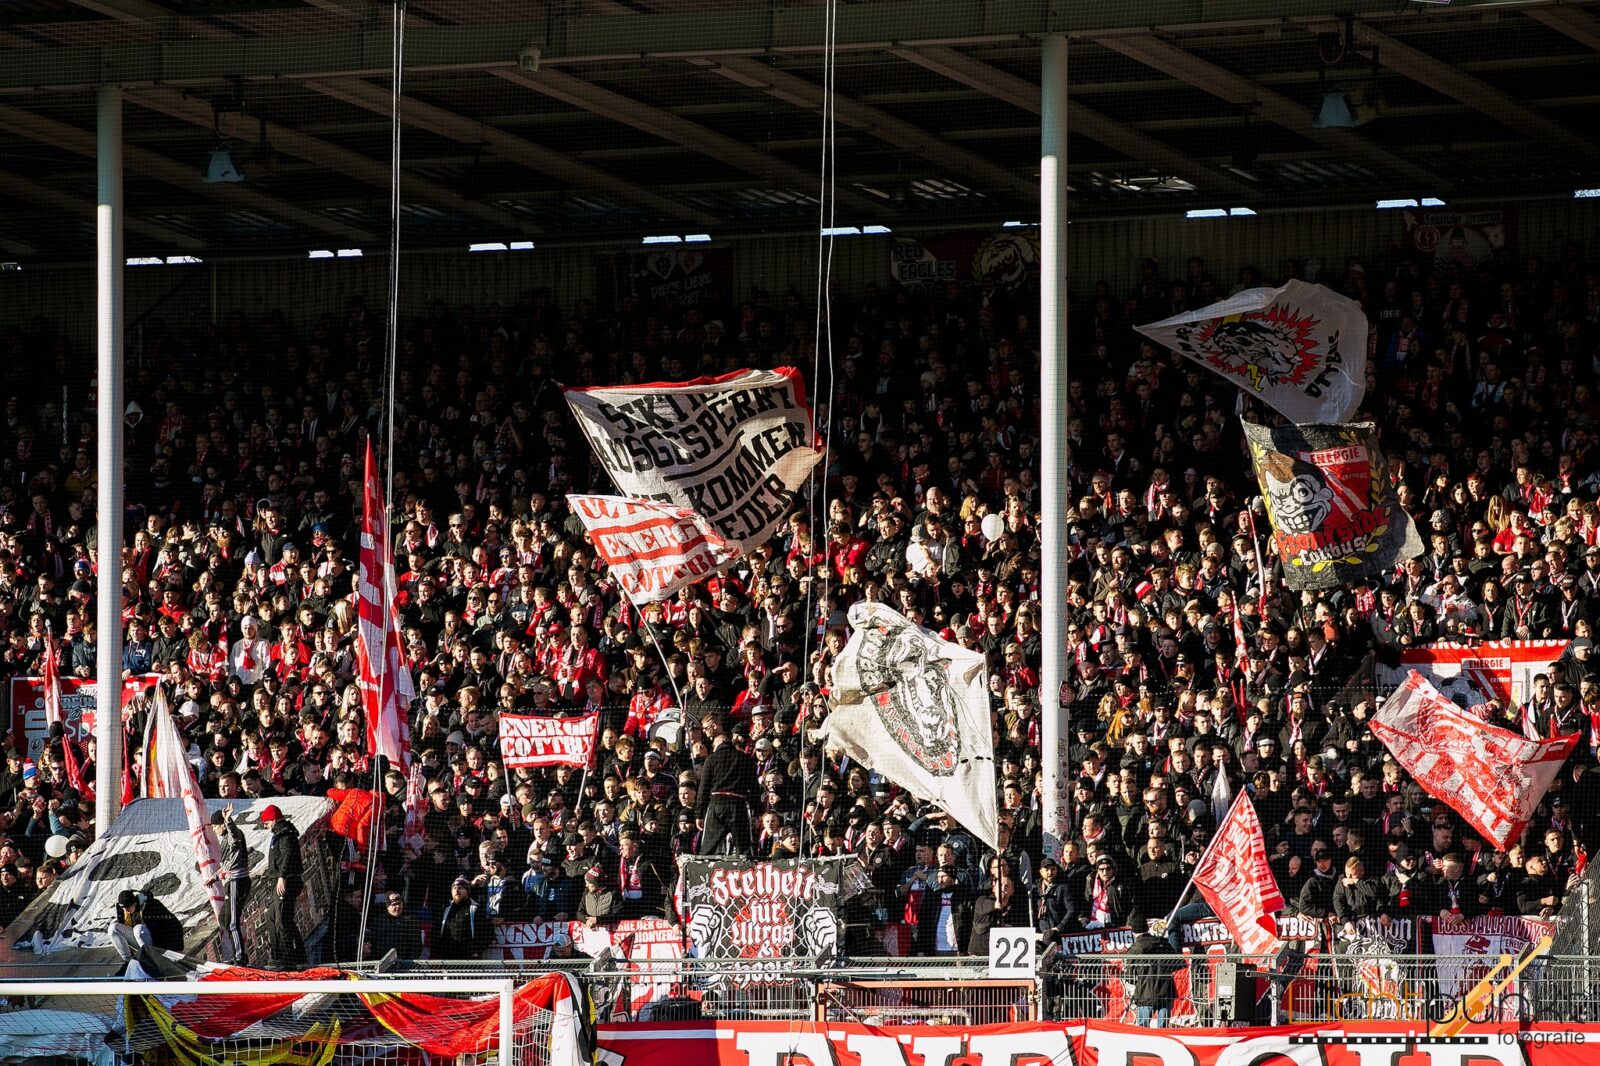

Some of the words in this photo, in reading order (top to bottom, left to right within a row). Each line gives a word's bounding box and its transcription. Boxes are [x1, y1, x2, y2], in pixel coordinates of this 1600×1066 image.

[1310, 447, 1360, 464] ENERGIE
[684, 422, 808, 518] KOMMEN
[711, 473, 797, 541] EDER
[1469, 659, 1504, 669] ENERGIE
[710, 863, 815, 906] Freiheit
[750, 898, 783, 925] für
[731, 921, 794, 946] Ultras
[1057, 933, 1103, 956] KTIVE
[994, 937, 1030, 968] 22
